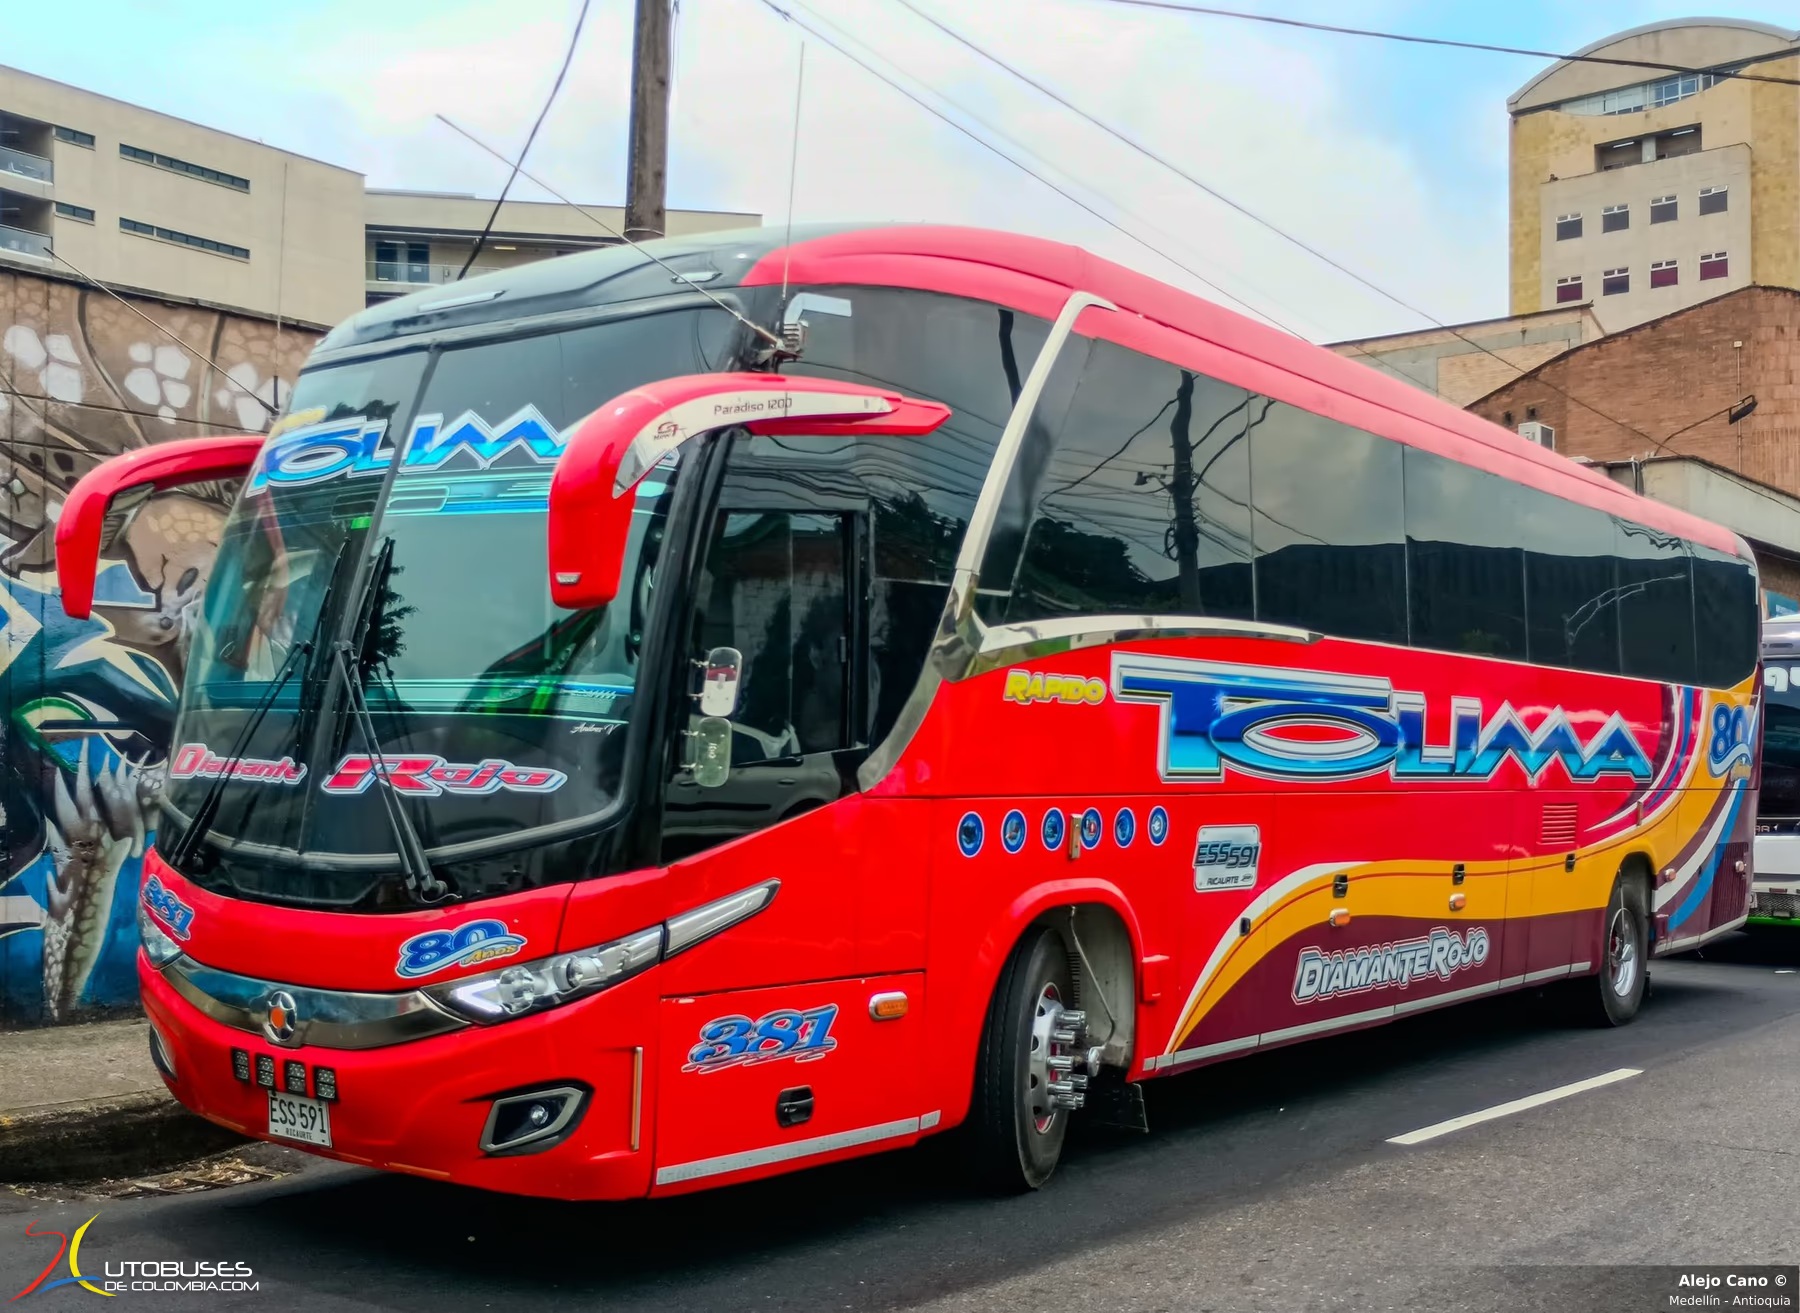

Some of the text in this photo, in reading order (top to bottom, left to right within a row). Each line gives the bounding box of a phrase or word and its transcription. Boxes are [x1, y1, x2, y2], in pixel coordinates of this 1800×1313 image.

[713, 402, 764, 415] Paradiso
[246, 403, 678, 498] TOLIM
[1003, 669, 1107, 705] RAPIDO
[1110, 651, 1654, 786] TOLIMA
[321, 753, 568, 797] Rojo
[142, 873, 195, 941] 381
[398, 919, 509, 972] 80
[682, 1003, 839, 1075] 381
